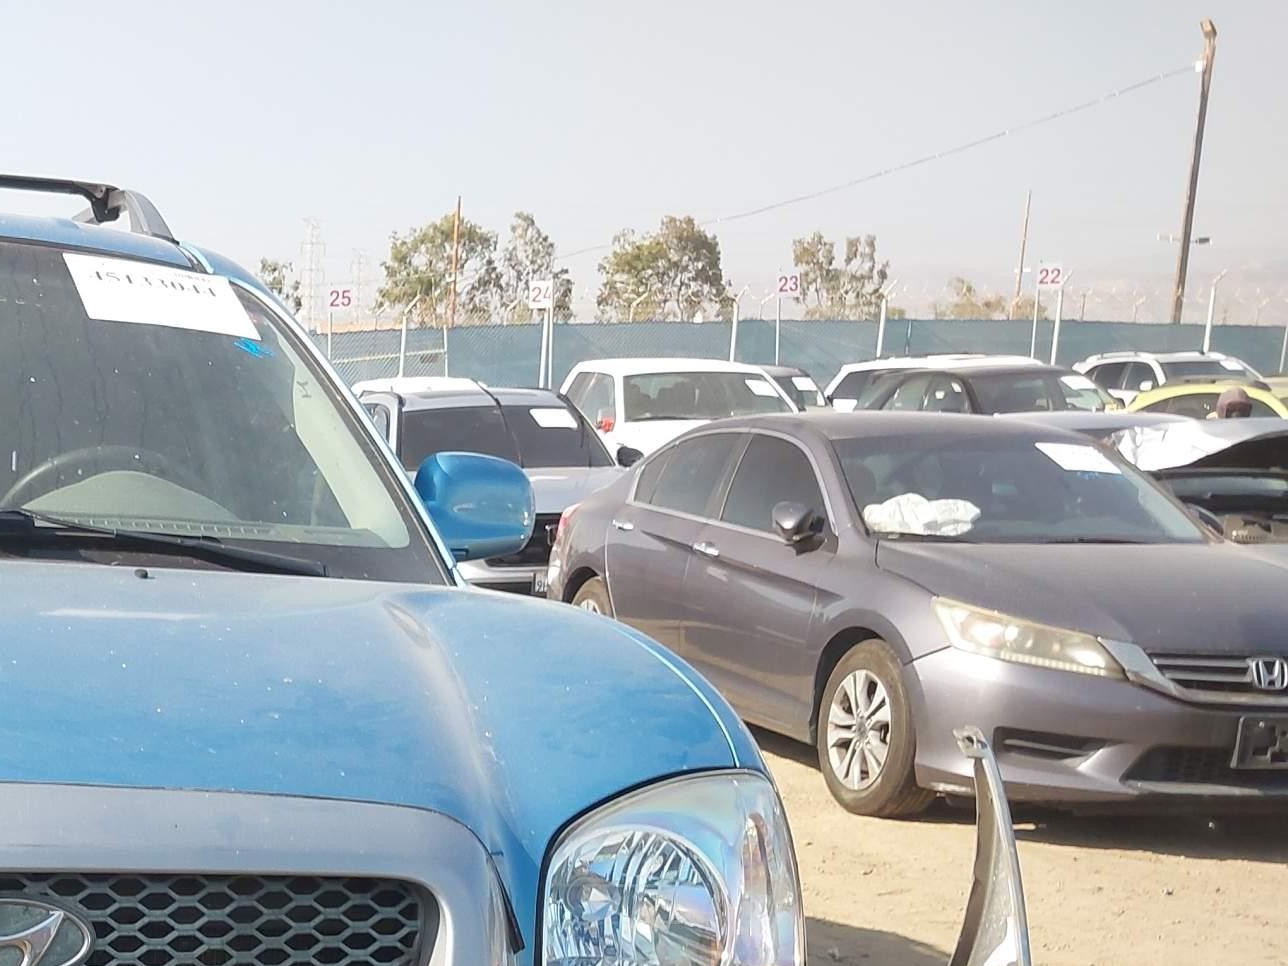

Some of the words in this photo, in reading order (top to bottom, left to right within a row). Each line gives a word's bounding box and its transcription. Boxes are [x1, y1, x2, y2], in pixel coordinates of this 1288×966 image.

[778, 275, 798, 292] 23
[1039, 267, 1061, 285] 22
[329, 289, 352, 307] 25
[531, 286, 552, 302] 24
